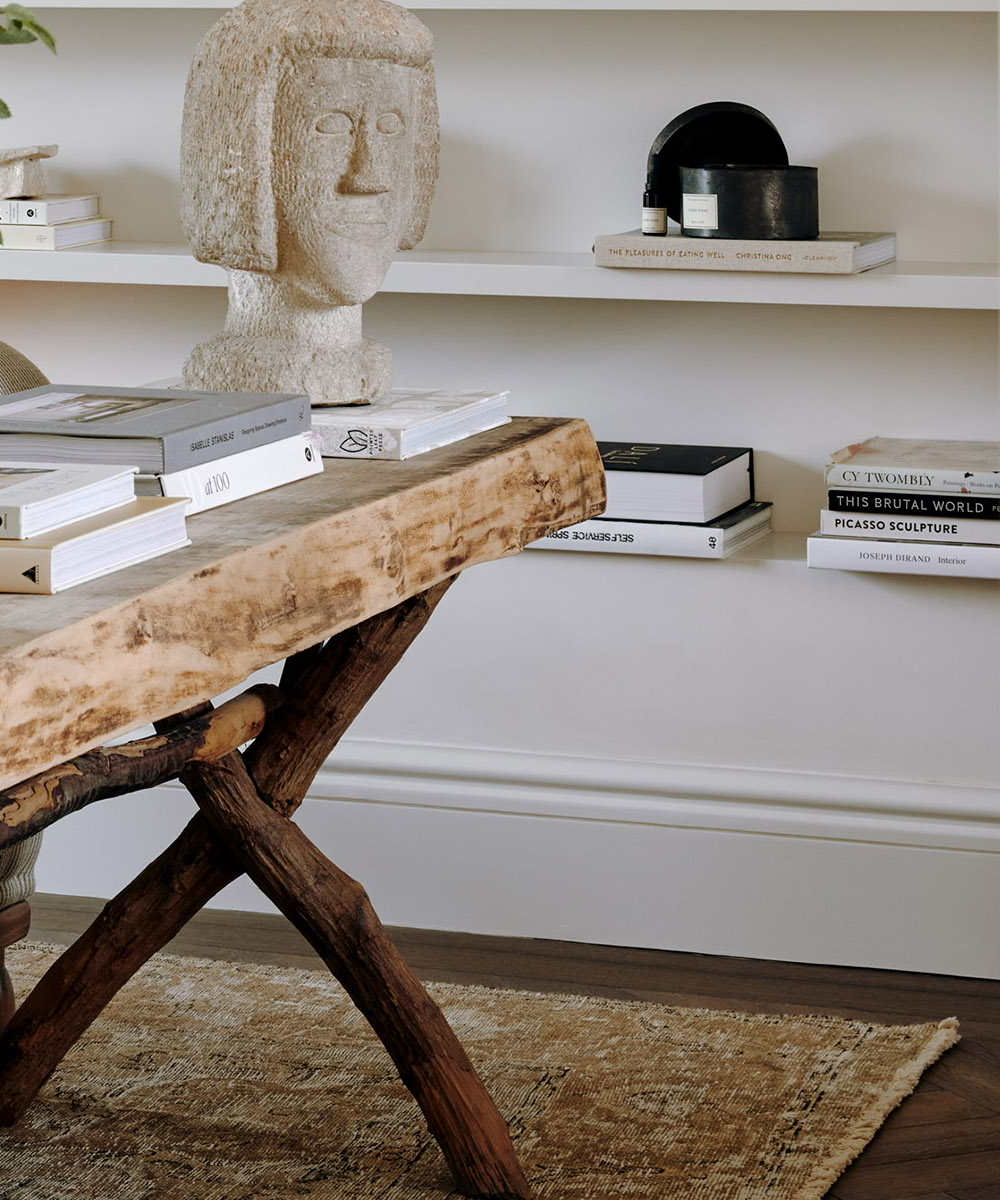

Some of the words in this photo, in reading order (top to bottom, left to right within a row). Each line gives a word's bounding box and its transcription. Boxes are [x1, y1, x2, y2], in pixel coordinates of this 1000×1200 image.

[625, 249, 664, 257] PLEASURES
[706, 251, 725, 259] WELL
[736, 252, 774, 260] CHRISTINA
[190, 438, 210, 452] ISABELLE
[211, 431, 235, 446] STANISLAS
[205, 477, 213, 496] at
[213, 472, 230, 492] 100
[842, 470, 860, 483] CY
[864, 472, 935, 487] TWOMBLY
[836, 496, 869, 508] THIS
[874, 498, 928, 511] BRUTAL
[932, 500, 984, 513] WORLD
[835, 518, 886, 530] PICASSO
[889, 521, 958, 534] SCULPTURE
[709, 537, 717, 549] 48
[858, 552, 893, 562] JOSEPH
[895, 553, 931, 563] DIRAND
[938, 556, 967, 565] Interior
